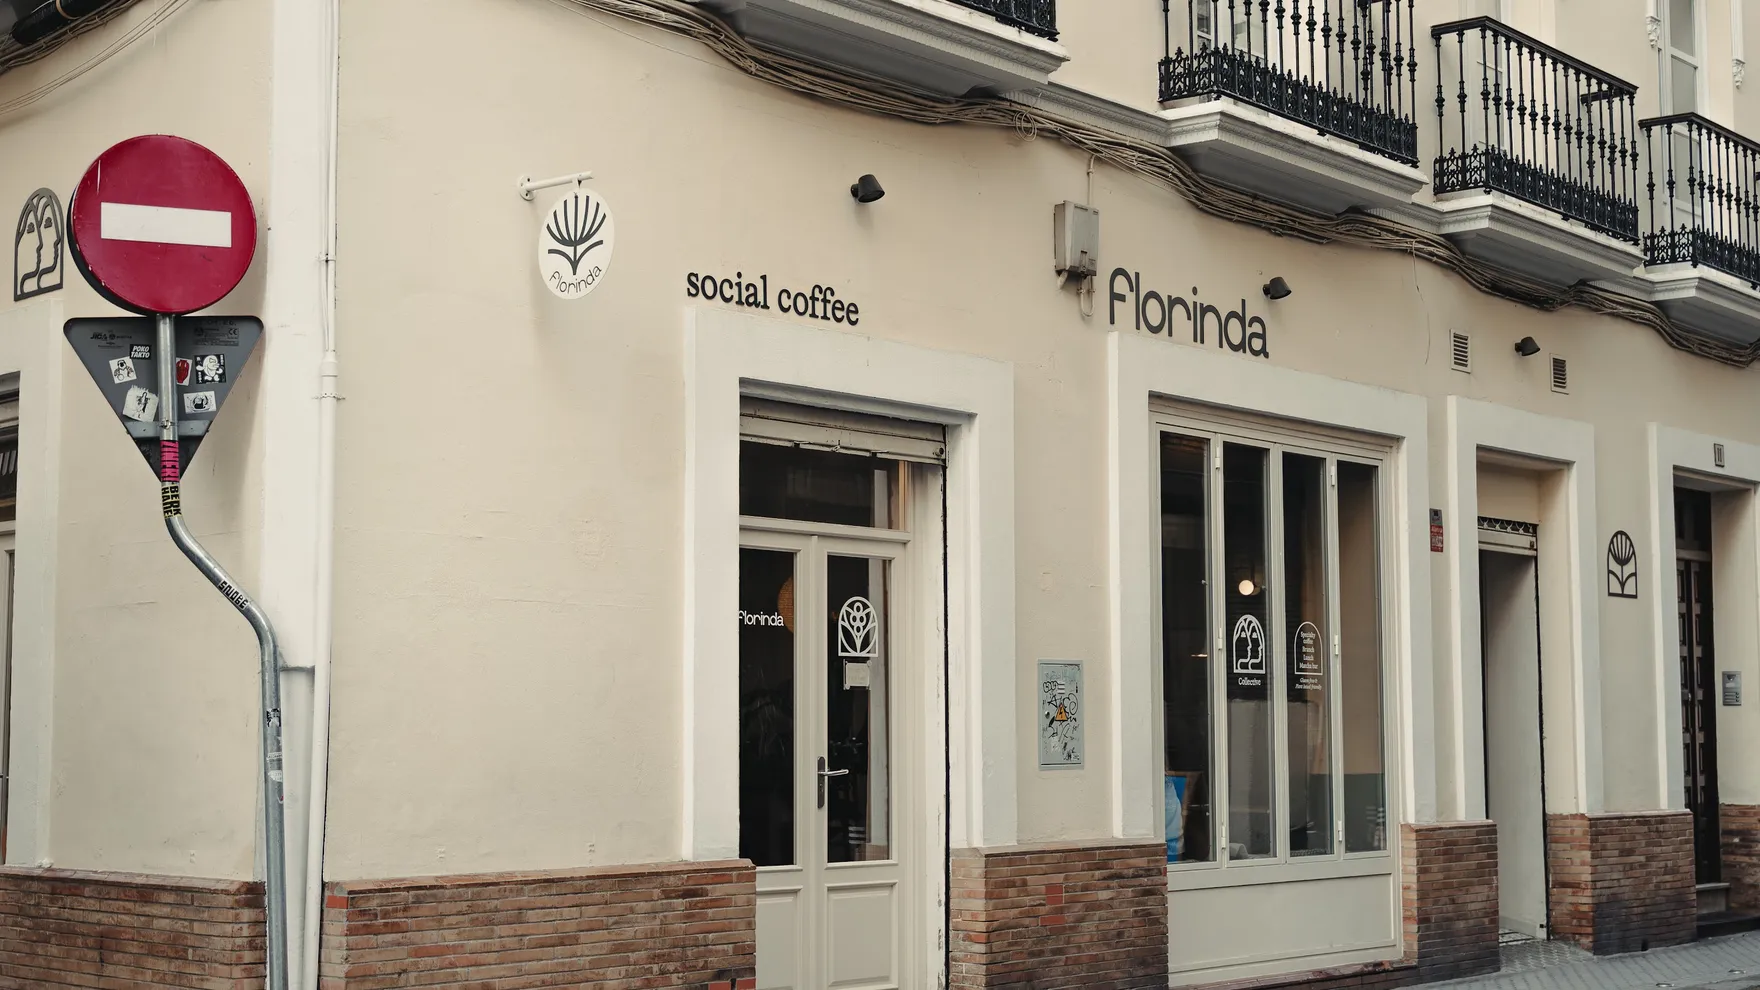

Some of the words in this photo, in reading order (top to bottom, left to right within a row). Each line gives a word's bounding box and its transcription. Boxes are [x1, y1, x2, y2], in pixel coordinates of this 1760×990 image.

[687, 271, 770, 310] social
[777, 284, 859, 326] coffee
[1109, 267, 1269, 359] florinda
